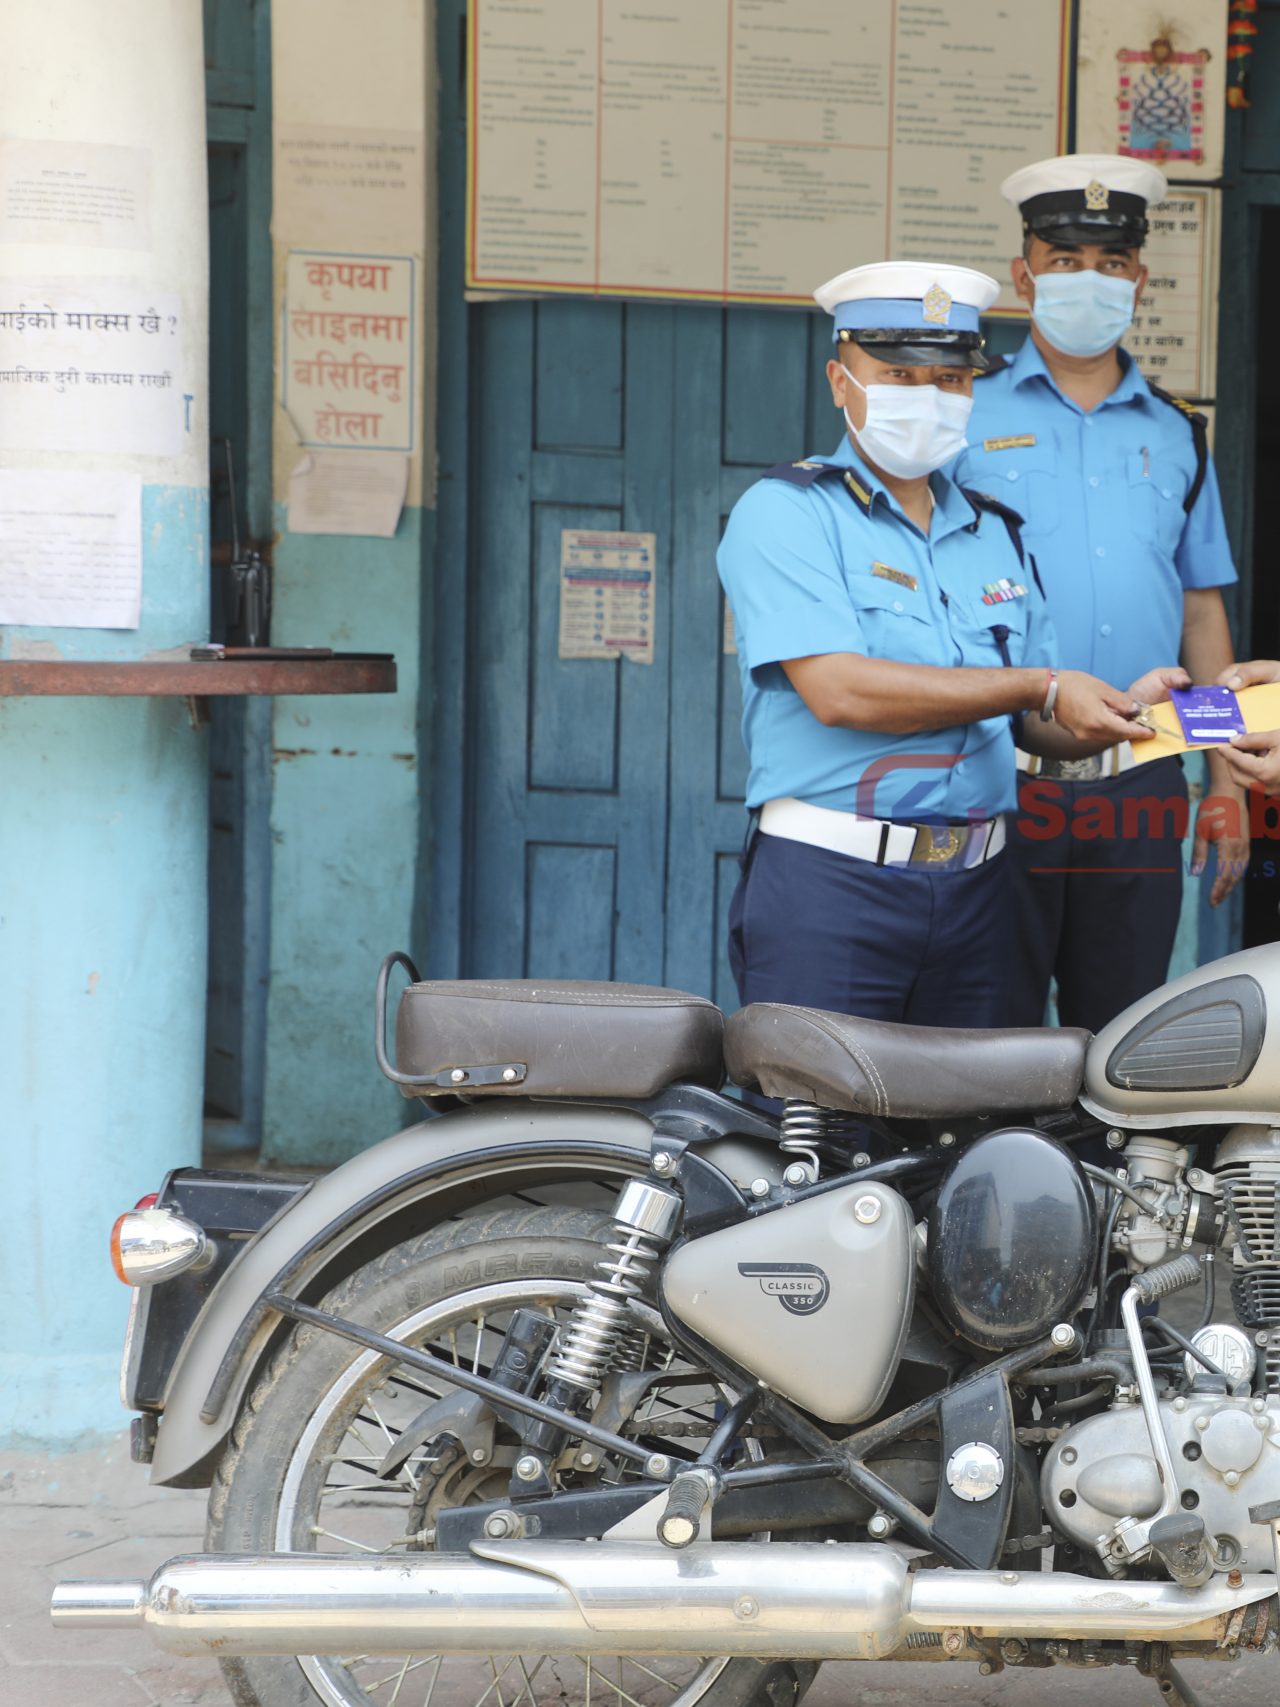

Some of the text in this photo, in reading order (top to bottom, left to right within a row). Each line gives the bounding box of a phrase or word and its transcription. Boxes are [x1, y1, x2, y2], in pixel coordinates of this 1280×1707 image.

[304, 260, 393, 302] कृपया
[313, 402, 384, 443] होला
[443, 1252, 553, 1290] MRF
[768, 1282, 814, 1291] CLASSIC
[793, 1297, 814, 1305] 350
